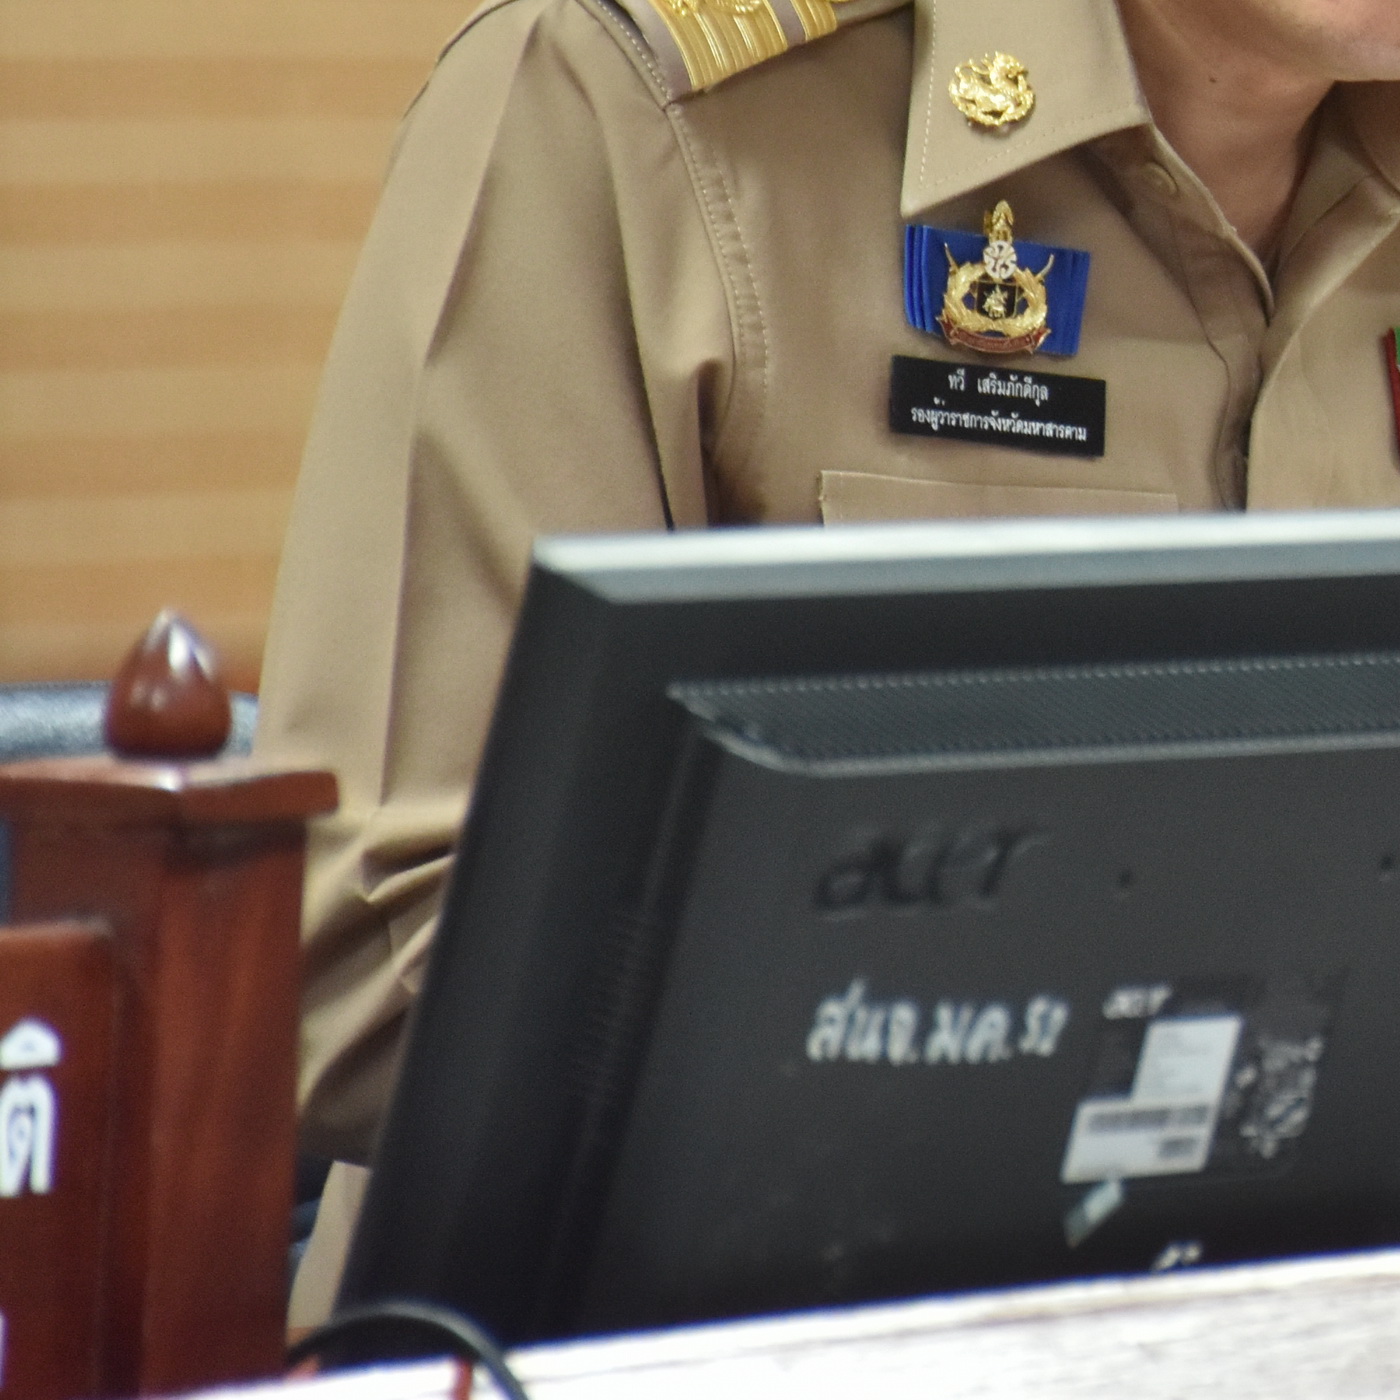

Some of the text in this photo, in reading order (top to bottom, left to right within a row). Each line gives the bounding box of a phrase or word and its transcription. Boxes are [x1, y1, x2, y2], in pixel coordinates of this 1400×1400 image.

[947, 368, 1049, 407] ทวี เสริมภักดีกุล
